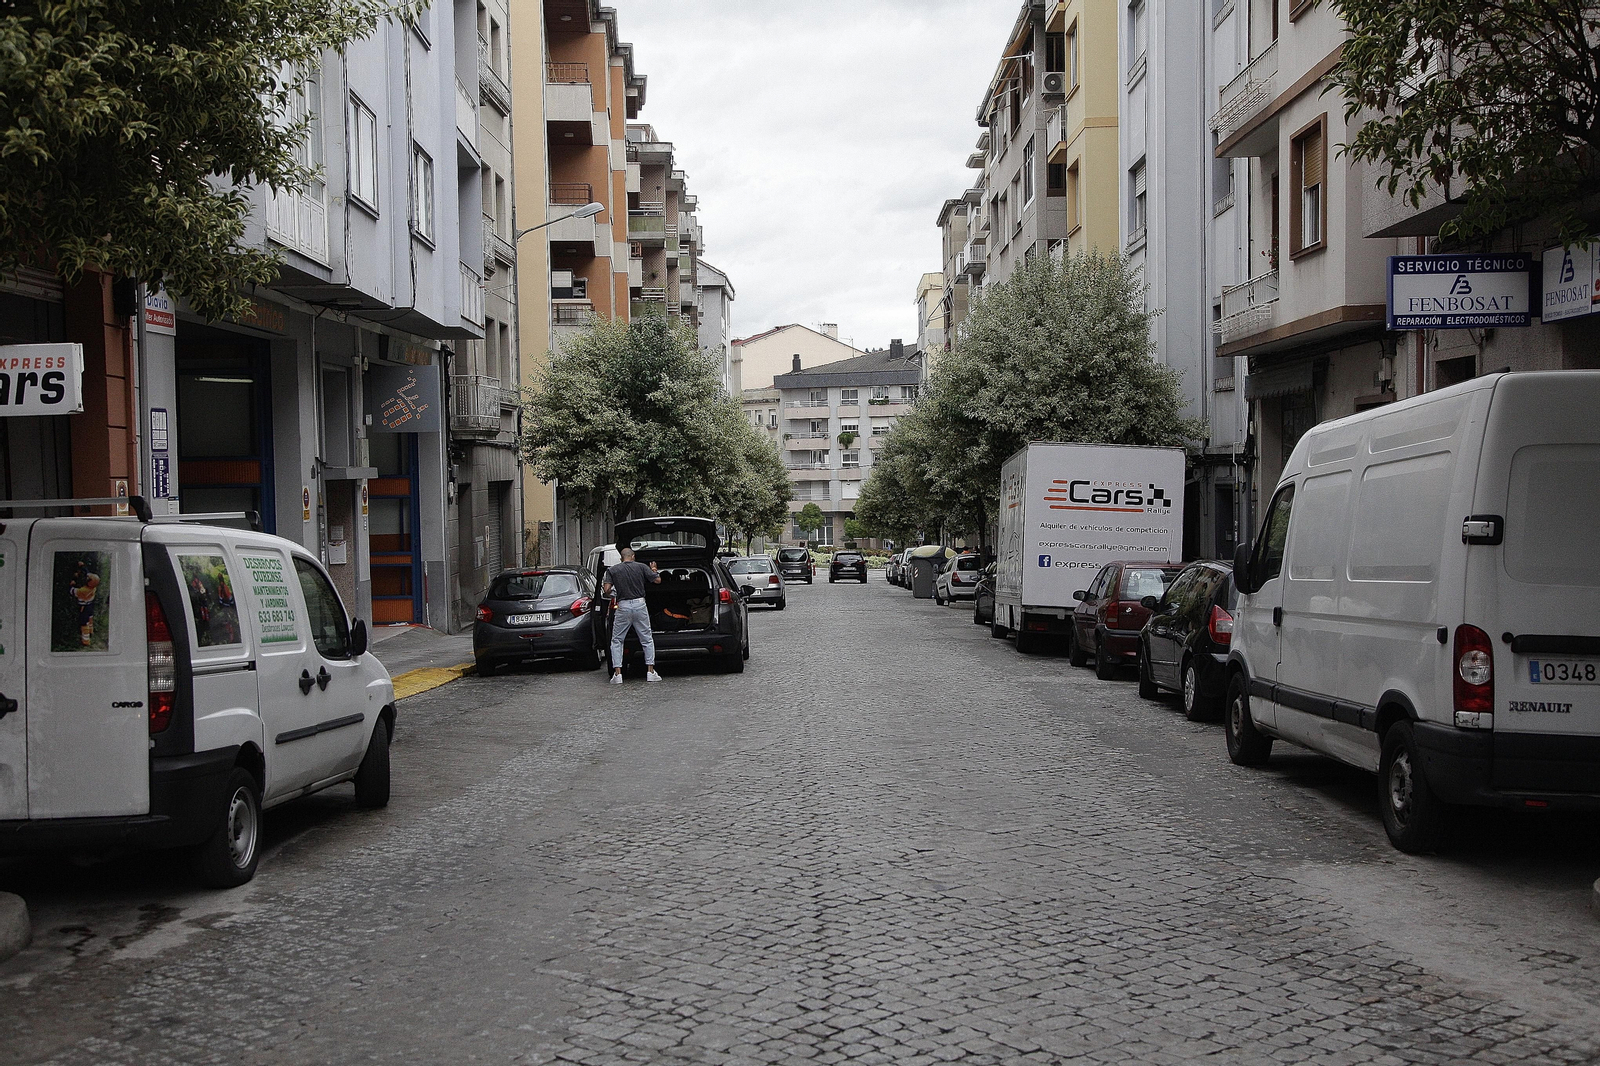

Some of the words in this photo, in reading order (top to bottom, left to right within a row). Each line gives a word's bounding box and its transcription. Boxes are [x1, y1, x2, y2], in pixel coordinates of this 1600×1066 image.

[1398, 260, 1460, 272] SERVICIO
[1467, 257, 1525, 271] TÉCNICO
[1545, 284, 1589, 307] FENBOSAT
[1409, 295, 1514, 312] FENBOSAT
[1396, 315, 1442, 326] REPARACIÓN
[1446, 313, 1526, 325] ELECTRODOMÉSTICOS
[1093, 480, 1142, 488] EXPRESS
[1069, 480, 1144, 505] Cars
[1147, 507, 1171, 515] Rallye
[1039, 522, 1067, 531] Alquiler
[1080, 524, 1113, 532] vehículos
[1126, 526, 1168, 535] competición
[1038, 540, 1168, 552] expresscarsrallye@gmail.com
[243, 557, 283, 570] DESBROCES
[252, 570, 284, 582] OURENSE
[252, 585, 289, 596] MANTENIMIENTOS
[260, 598, 265, 608] Y
[258, 610, 271, 623] 633
[272, 610, 284, 622] 683
[284, 610, 295, 622] 743
[515, 614, 534, 623] 8497
[536, 613, 550, 621] HYL
[1544, 663, 1597, 681] 0348
[1508, 701, 1573, 713] RENAULT
